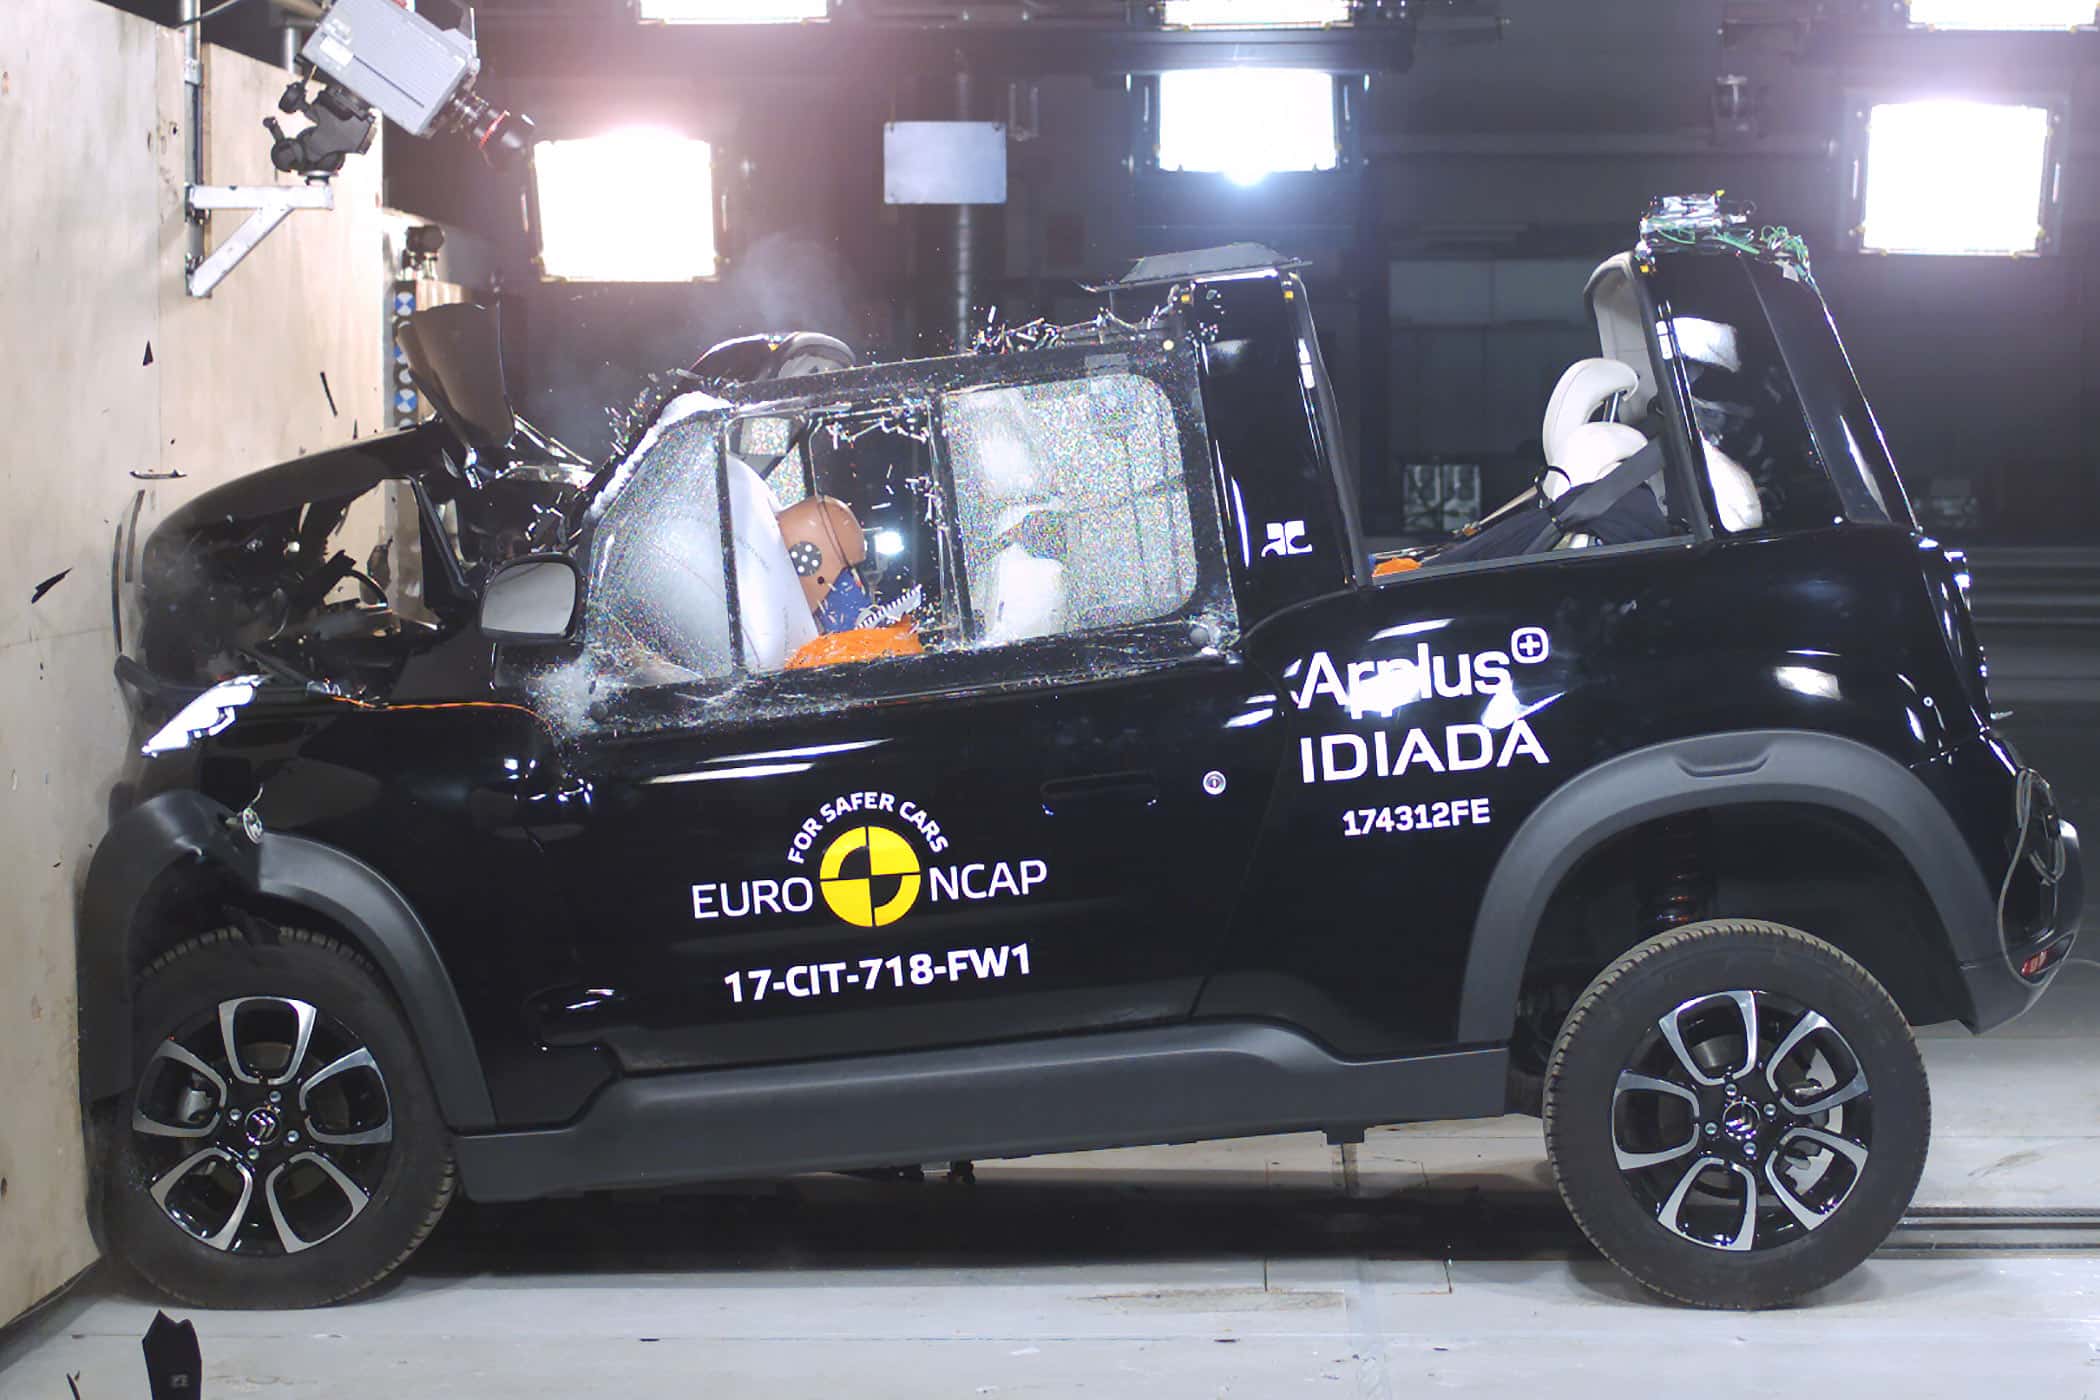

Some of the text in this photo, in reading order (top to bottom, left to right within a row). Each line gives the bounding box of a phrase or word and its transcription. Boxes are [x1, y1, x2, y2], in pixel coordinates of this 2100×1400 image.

[1300, 719, 1550, 783] IDIADA
[787, 791, 949, 864] FOR SAFER CARS
[1342, 798, 1491, 837] 174312FE
[691, 859, 1048, 919] EURO NCAP
[724, 943, 1030, 1003] 17-CIT-718-FW1
